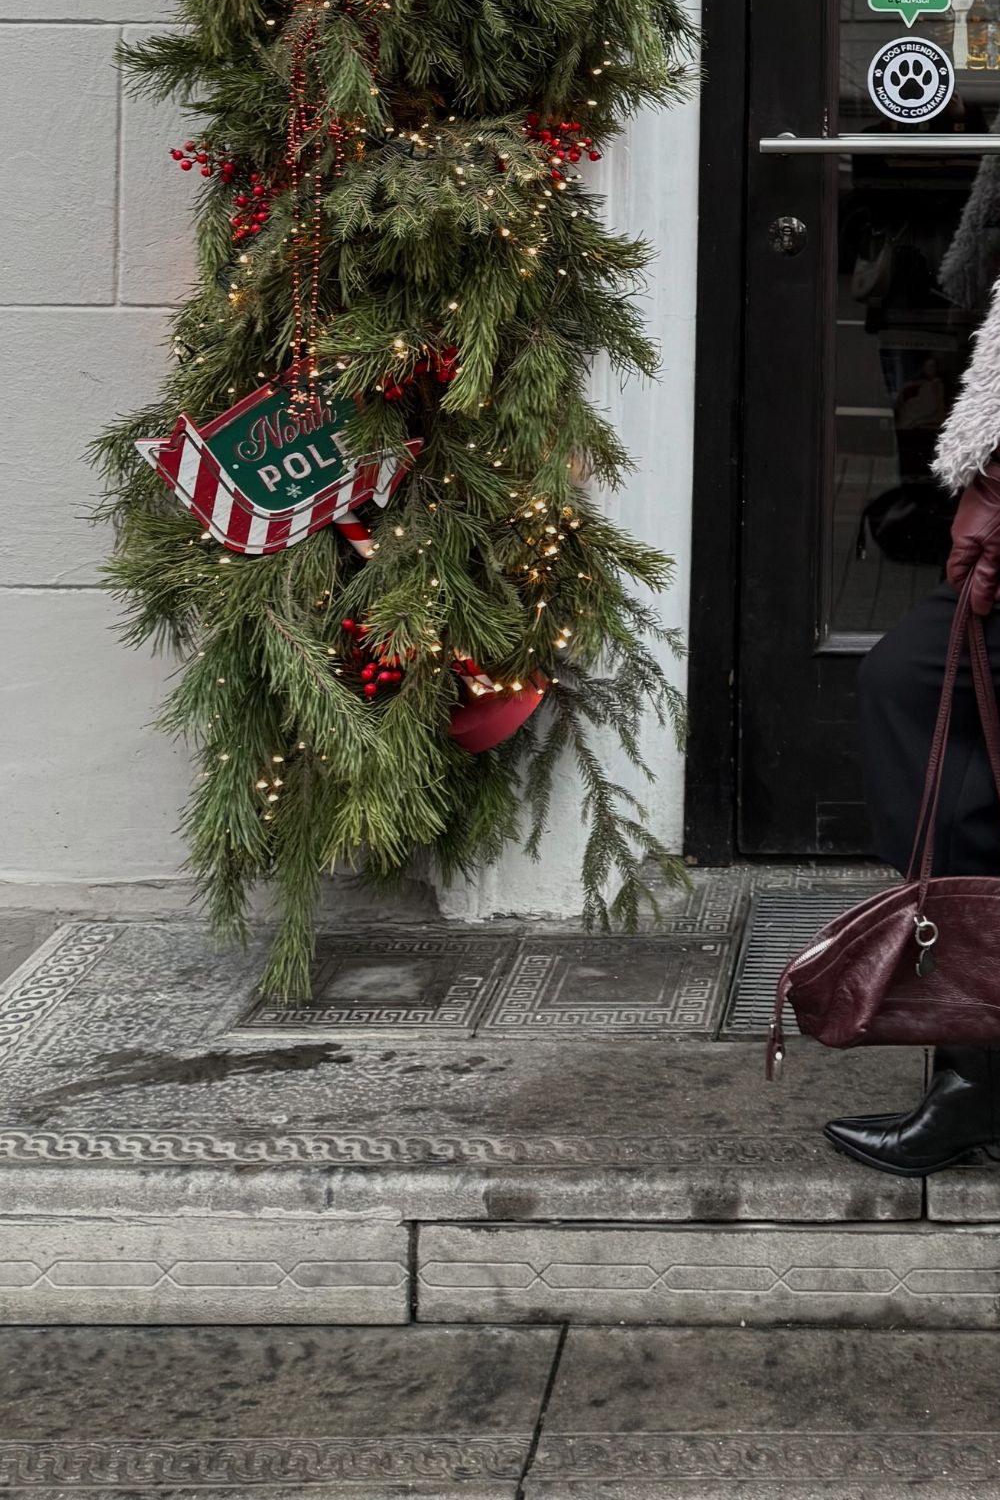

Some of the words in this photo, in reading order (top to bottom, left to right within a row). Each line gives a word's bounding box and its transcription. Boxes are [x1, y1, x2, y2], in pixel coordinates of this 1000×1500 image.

[882, 46, 901, 62] DOG
[901, 44, 941, 61] FRIENDLY
[876, 86, 901, 113] МОЖНО
[909, 84, 947, 116] СОБАКАМИ
